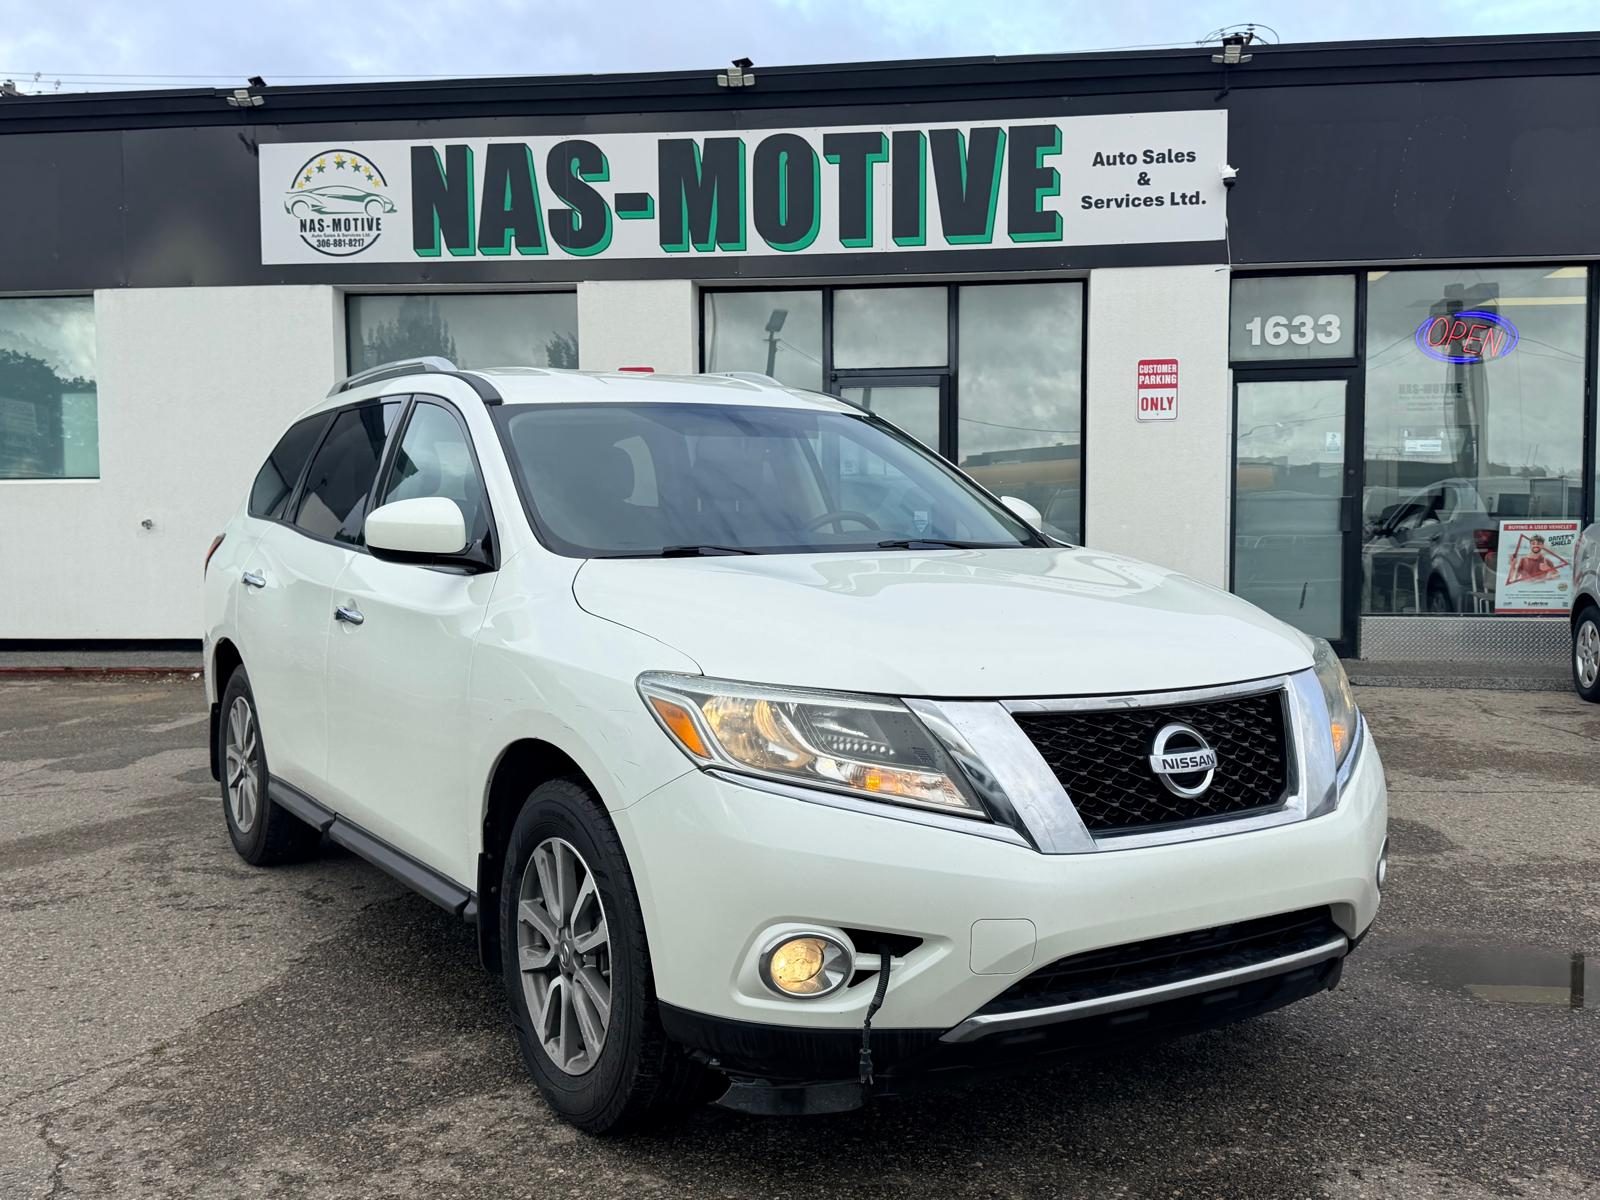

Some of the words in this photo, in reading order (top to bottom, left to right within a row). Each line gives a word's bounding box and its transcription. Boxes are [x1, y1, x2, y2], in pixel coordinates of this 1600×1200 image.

[1092, 151, 1138, 167] Auto
[1142, 148, 1197, 165] Sales
[1137, 171, 1151, 186] &
[411, 124, 1063, 257] NAS-MOTIVE
[1080, 193, 1165, 210] Services
[1170, 191, 1207, 206] Ltd.
[300, 218, 381, 232] NAS-MOTIVE
[316, 238, 364, 247] 306-881-8217
[1246, 314, 1341, 346] 1633
[1427, 317, 1504, 357] OPEN
[1139, 364, 1177, 374] CUSTOMER
[1139, 375, 1177, 385] PARKING
[1141, 396, 1174, 411] ONLY
[1161, 754, 1215, 770] NISSAN
